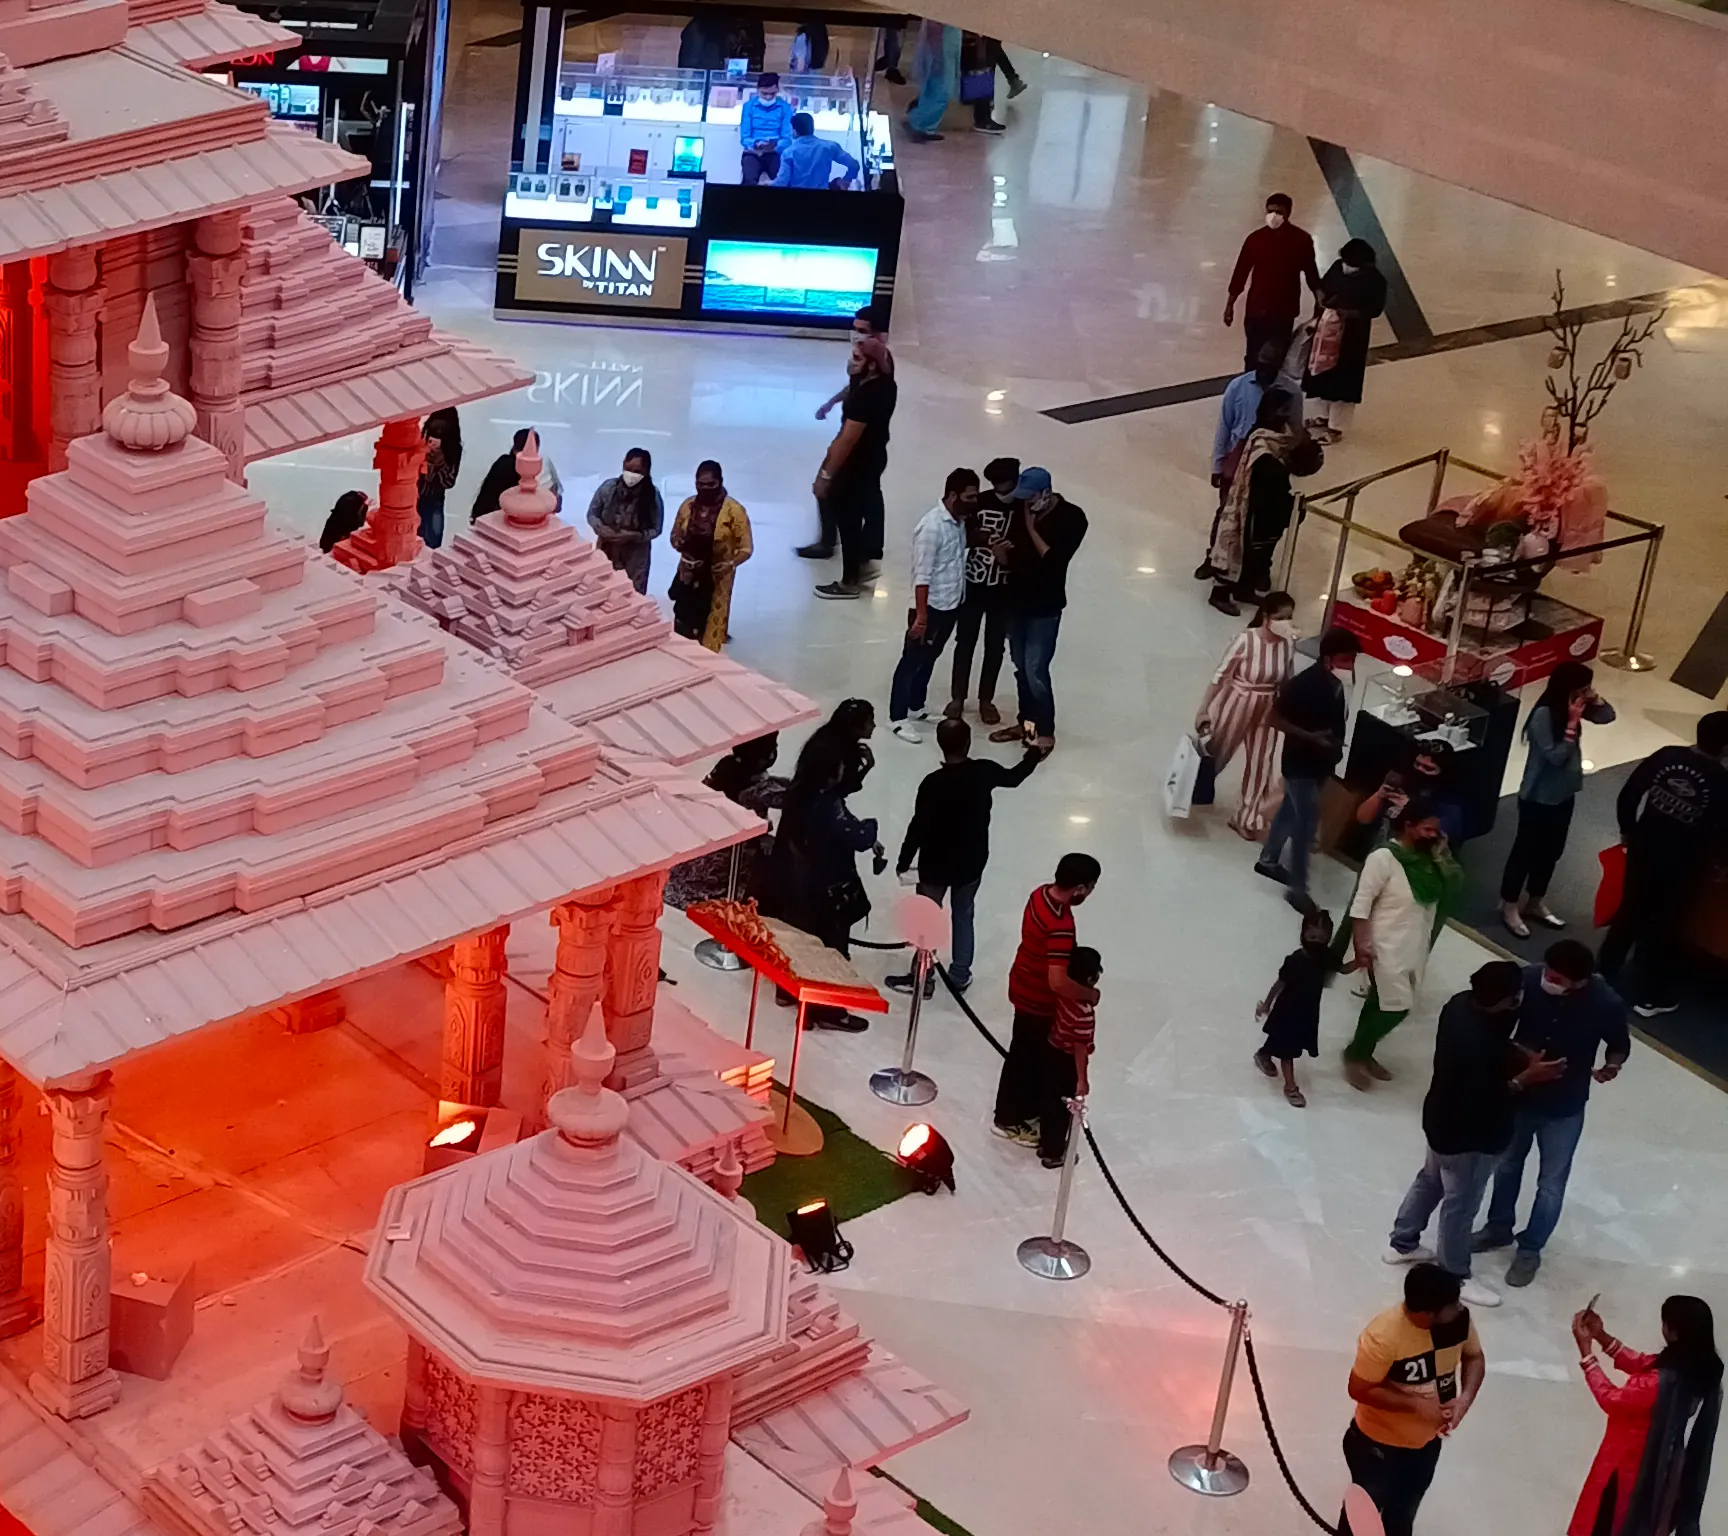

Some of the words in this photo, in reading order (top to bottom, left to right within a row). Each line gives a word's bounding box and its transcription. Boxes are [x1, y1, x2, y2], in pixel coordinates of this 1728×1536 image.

[537, 242, 658, 282] SKINN
[596, 281, 654, 297] TITAN
[1404, 1357, 1428, 1382] 21
